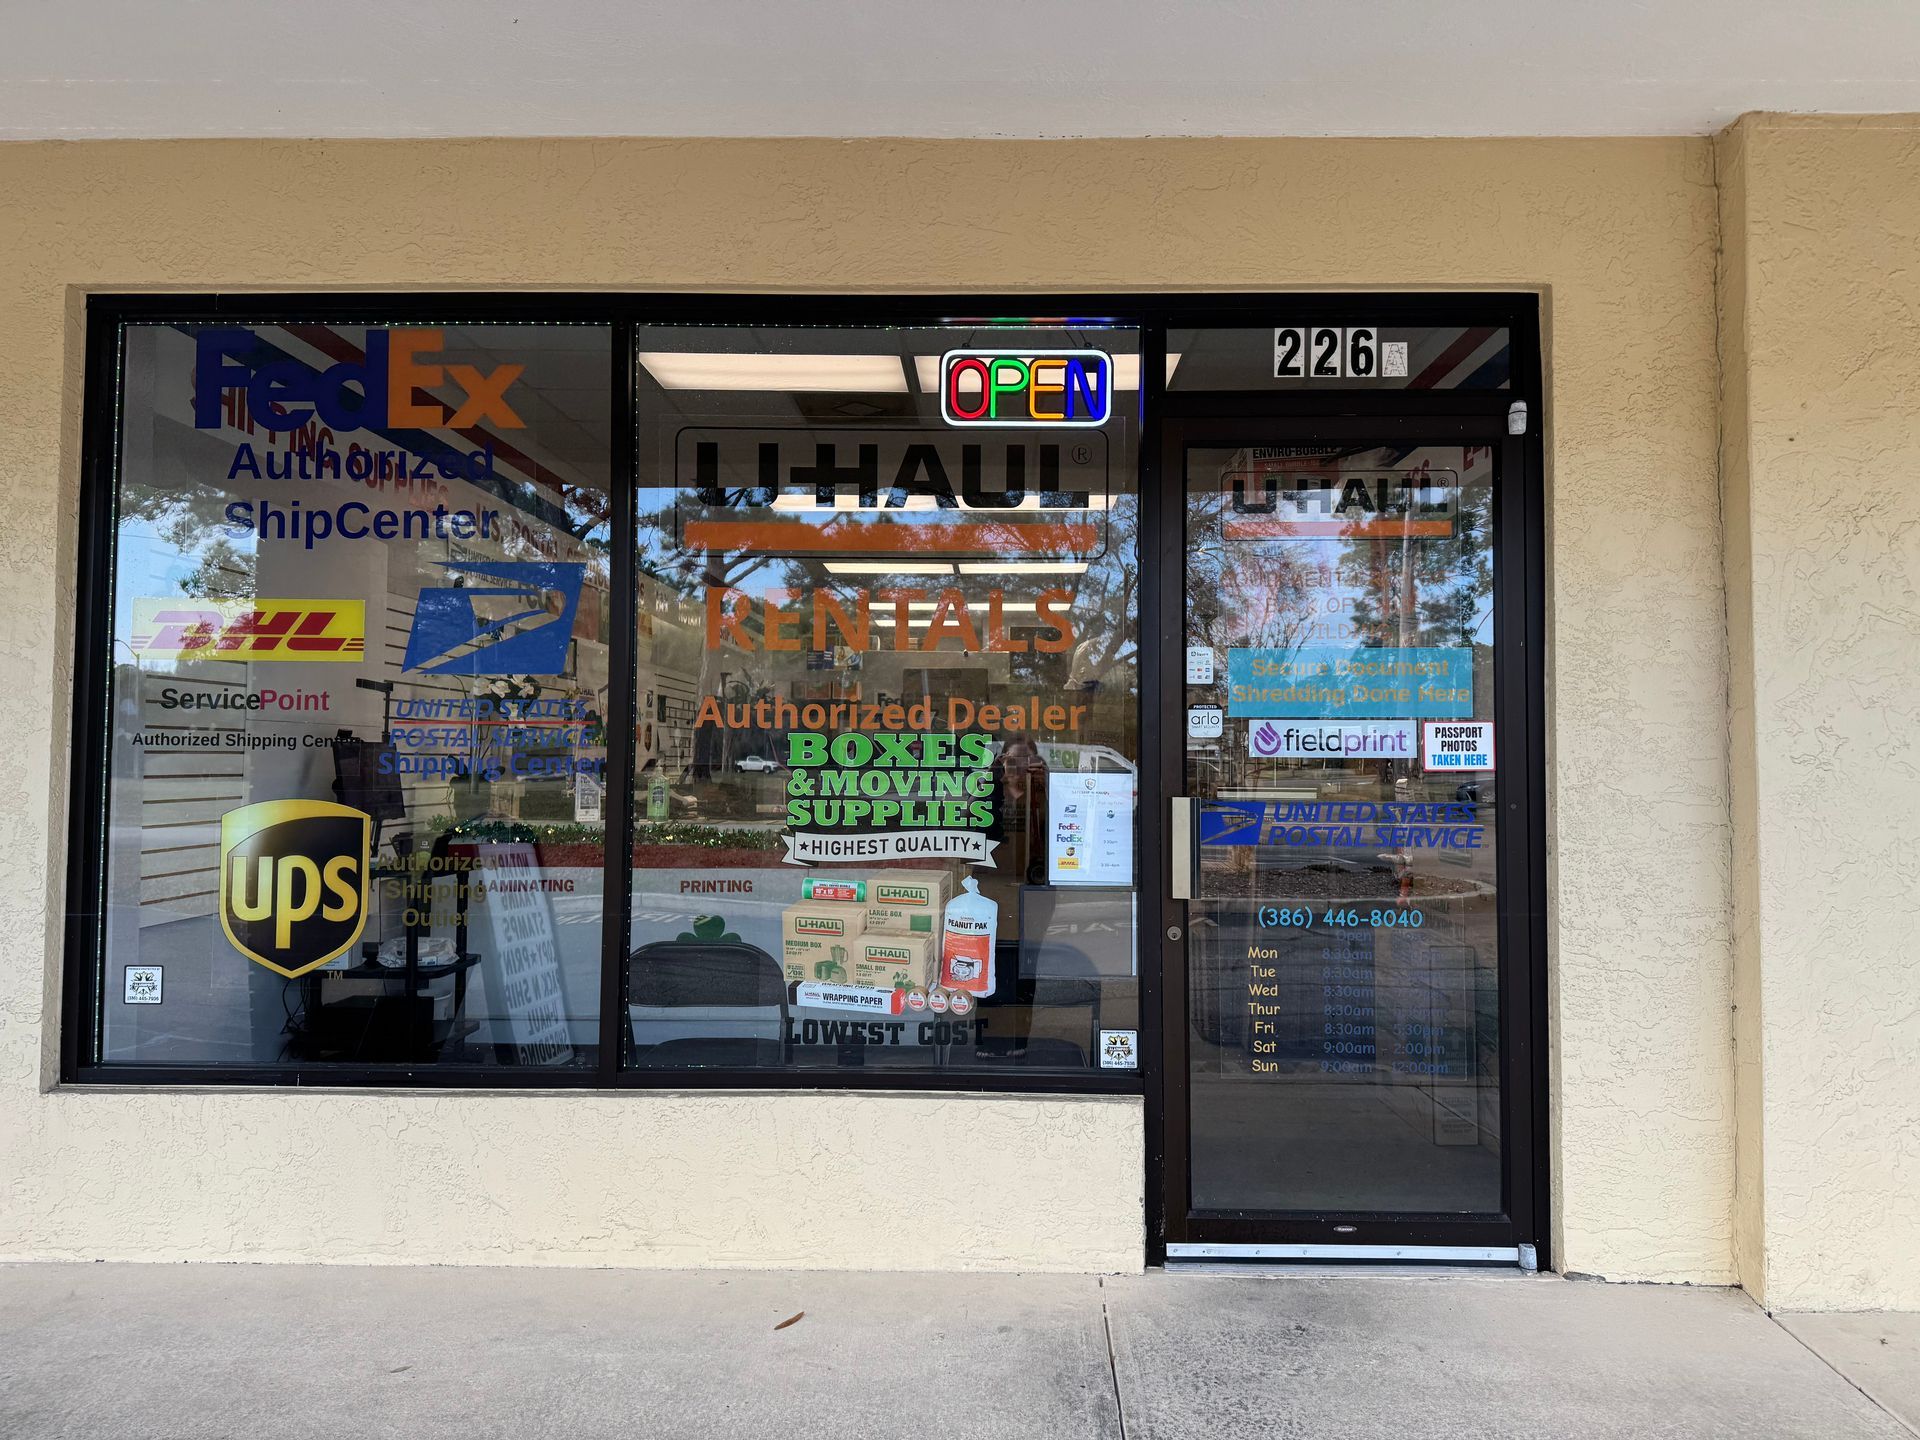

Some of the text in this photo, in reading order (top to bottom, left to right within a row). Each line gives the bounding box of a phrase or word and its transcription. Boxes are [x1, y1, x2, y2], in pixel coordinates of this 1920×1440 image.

[195, 329, 527, 431] FedEx
[950, 358, 1106, 420] OPEN
[227, 440, 494, 482] Authorized
[697, 441, 1089, 509] U-HAUL
[1232, 478, 1448, 514] U-HAUL
[225, 500, 498, 549] ShipCenter
[705, 586, 1077, 653] RENTALS
[148, 611, 346, 651] DHL
[1252, 659, 1450, 677] Secure Document
[161, 688, 330, 711] ServicePoint
[1232, 685, 1470, 706] Shredding Done Here
[396, 698, 590, 718] UNITED STATES
[695, 695, 1087, 732] Authorized Dealer
[1190, 712, 1220, 725] arlo
[132, 732, 220, 747] Authorized
[225, 733, 297, 750] Shipping
[389, 728, 597, 747] POSTAL SERVICE
[1283, 728, 1408, 756] fieldprint
[1434, 726, 1483, 739] PASSPORT
[787, 732, 995, 768] BOXES
[1440, 740, 1478, 752] PHOTOS
[377, 751, 607, 782] Shipping Center
[1431, 754, 1488, 766] TAKEN HERE
[820, 769, 995, 798] MOVING
[787, 799, 995, 828] SUPPLIES
[1274, 802, 1477, 824] UNITED STATES
[811, 836, 971, 856] HIGHEST QUALITY
[1267, 826, 1484, 849] POSTAL SERVICE
[385, 879, 487, 904] Shipping
[680, 880, 753, 893] PRINTING
[880, 887, 926, 899] U-HAUL
[231, 855, 359, 949] ups
[401, 908, 469, 927] Outlet
[798, 919, 842, 931] U-HAUL
[948, 918, 973, 930] PEANUT
[974, 921, 988, 930] PAK
[1258, 905, 1424, 930] (386) 446-8040
[868, 948, 908, 959] U-HAUL
[1248, 947, 1278, 960] Mon
[1251, 966, 1276, 978] Tue
[822, 992, 859, 1004] WRAPPING
[860, 996, 883, 1006] PAPER
[1248, 984, 1278, 997] Wed
[1248, 1003, 1281, 1016] Thur
[784, 1017, 989, 1046] LOWEST COST
[1254, 1021, 1275, 1034] Fri
[1324, 1022, 1375, 1036] 8:30am
[1253, 1041, 1276, 1054] Sat
[1324, 1041, 1376, 1054] 9:00am
[1252, 1060, 1279, 1073] Sun
